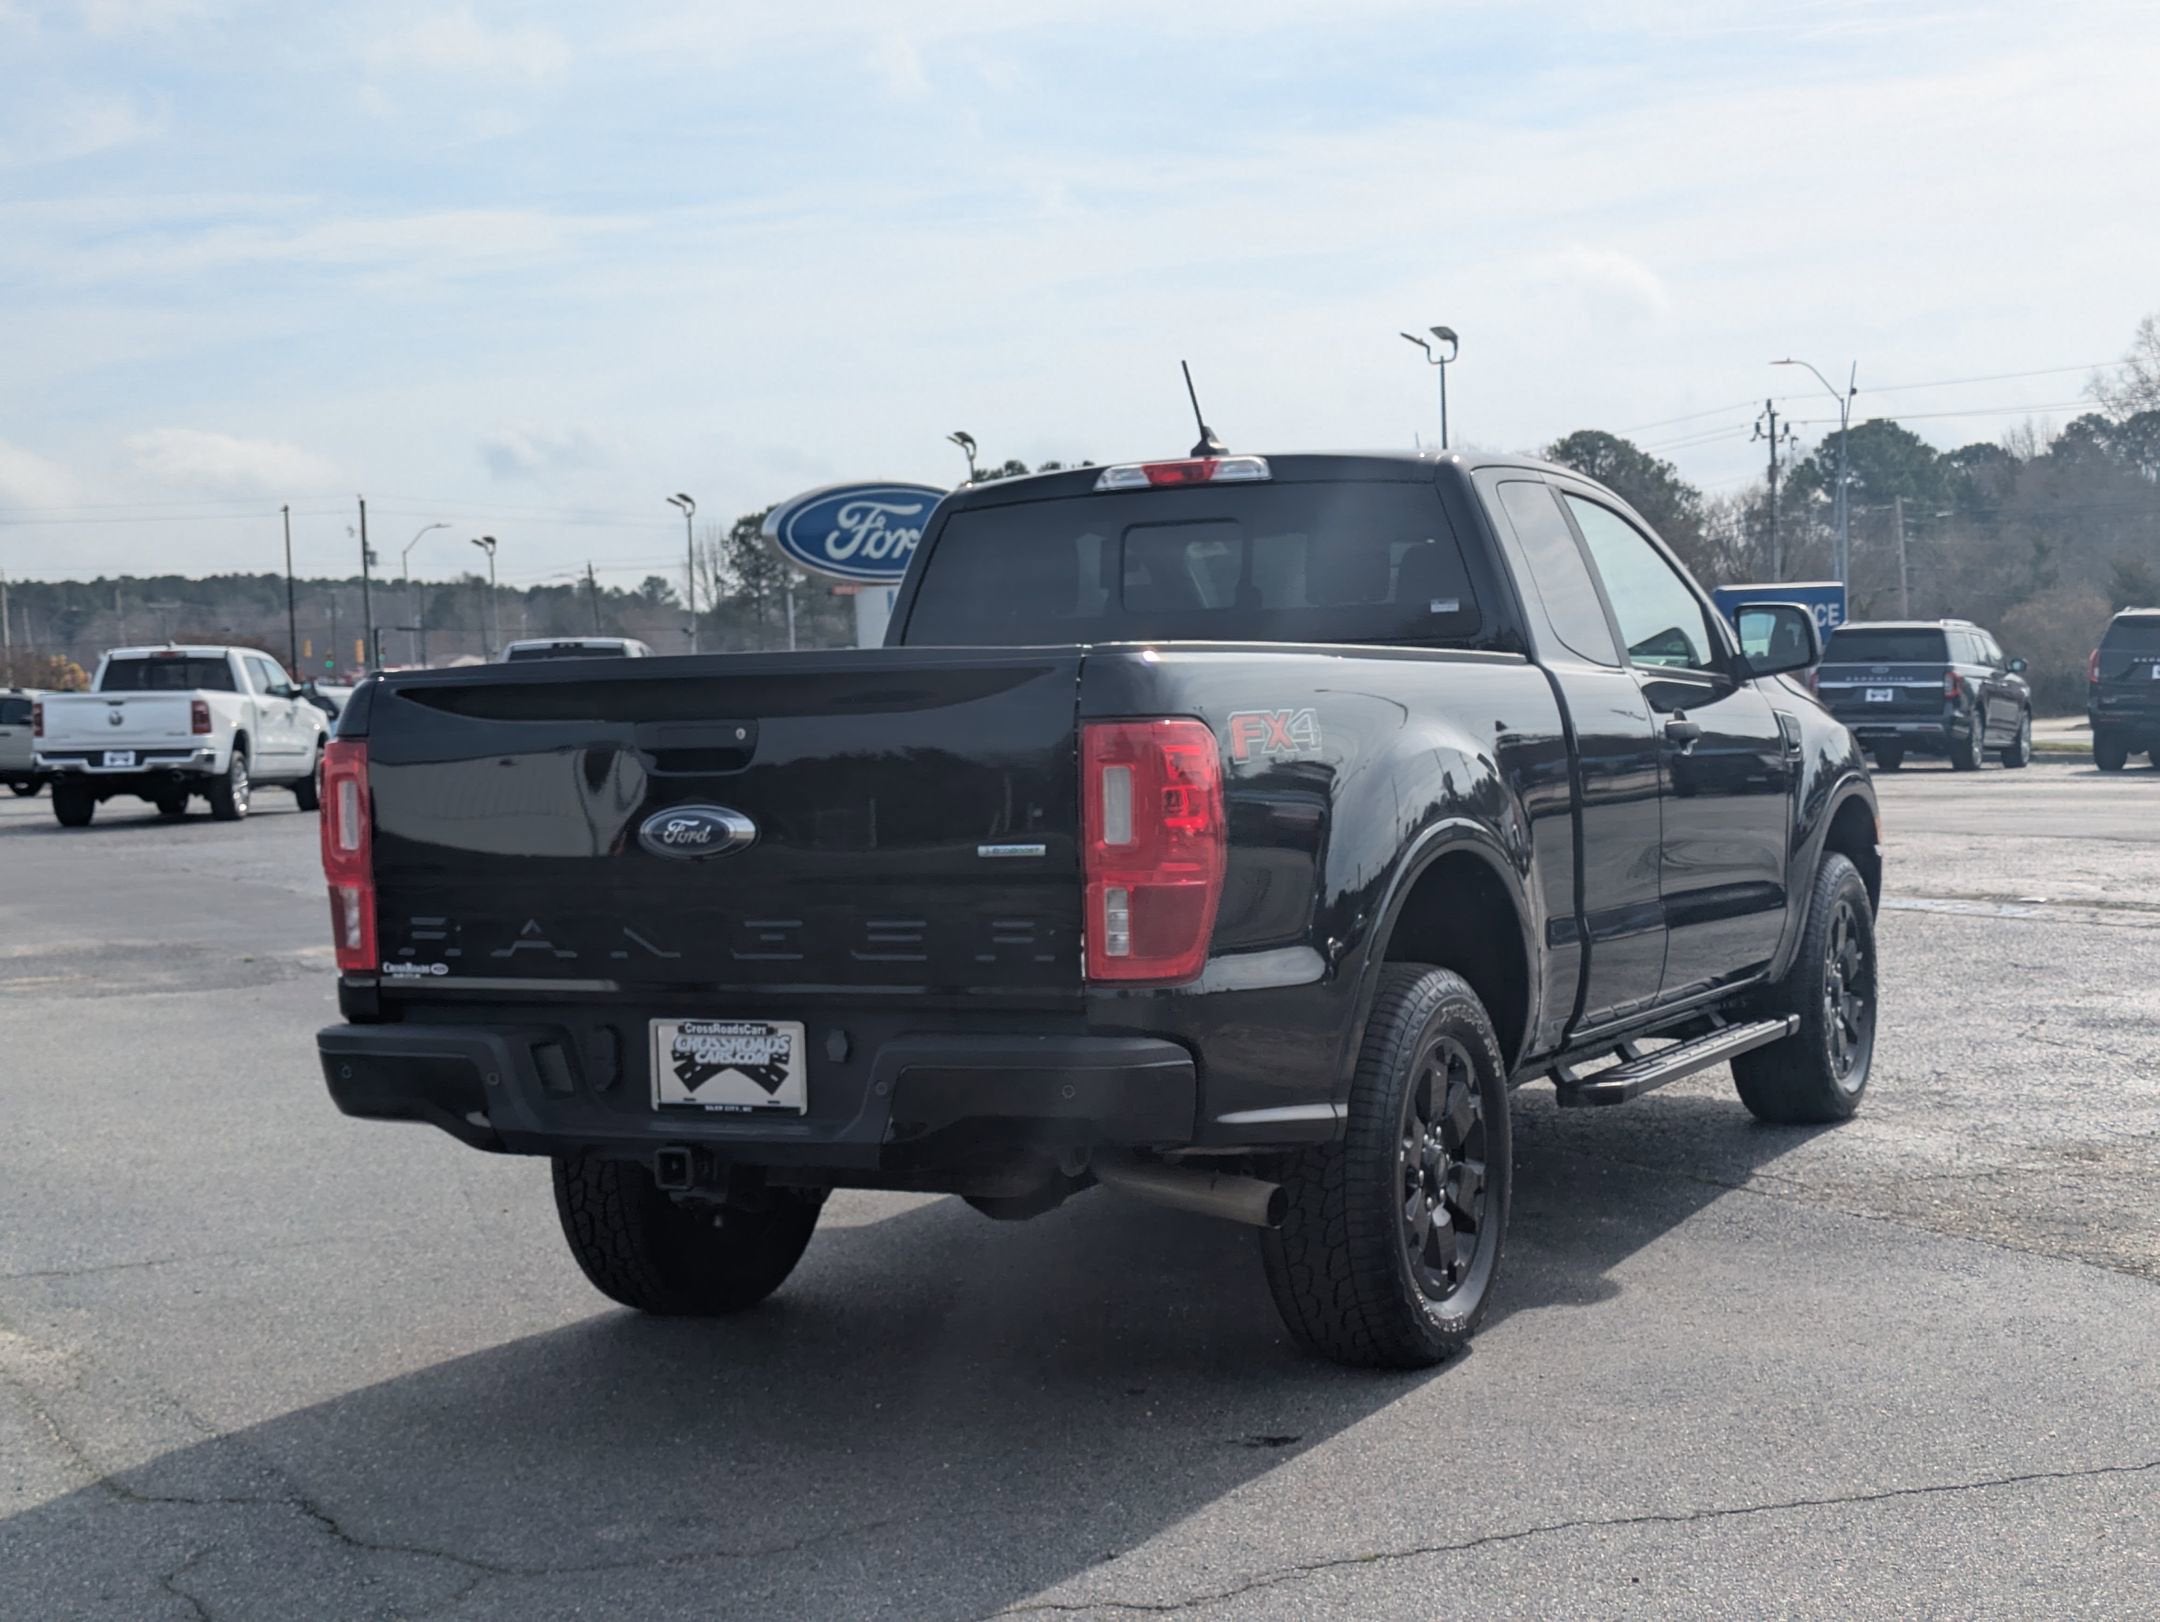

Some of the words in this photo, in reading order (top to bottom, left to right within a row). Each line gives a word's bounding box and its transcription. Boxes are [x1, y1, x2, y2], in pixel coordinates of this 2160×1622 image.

[825, 501, 923, 560] For
[1227, 708, 1322, 764] FX4
[663, 819, 712, 844] Ford
